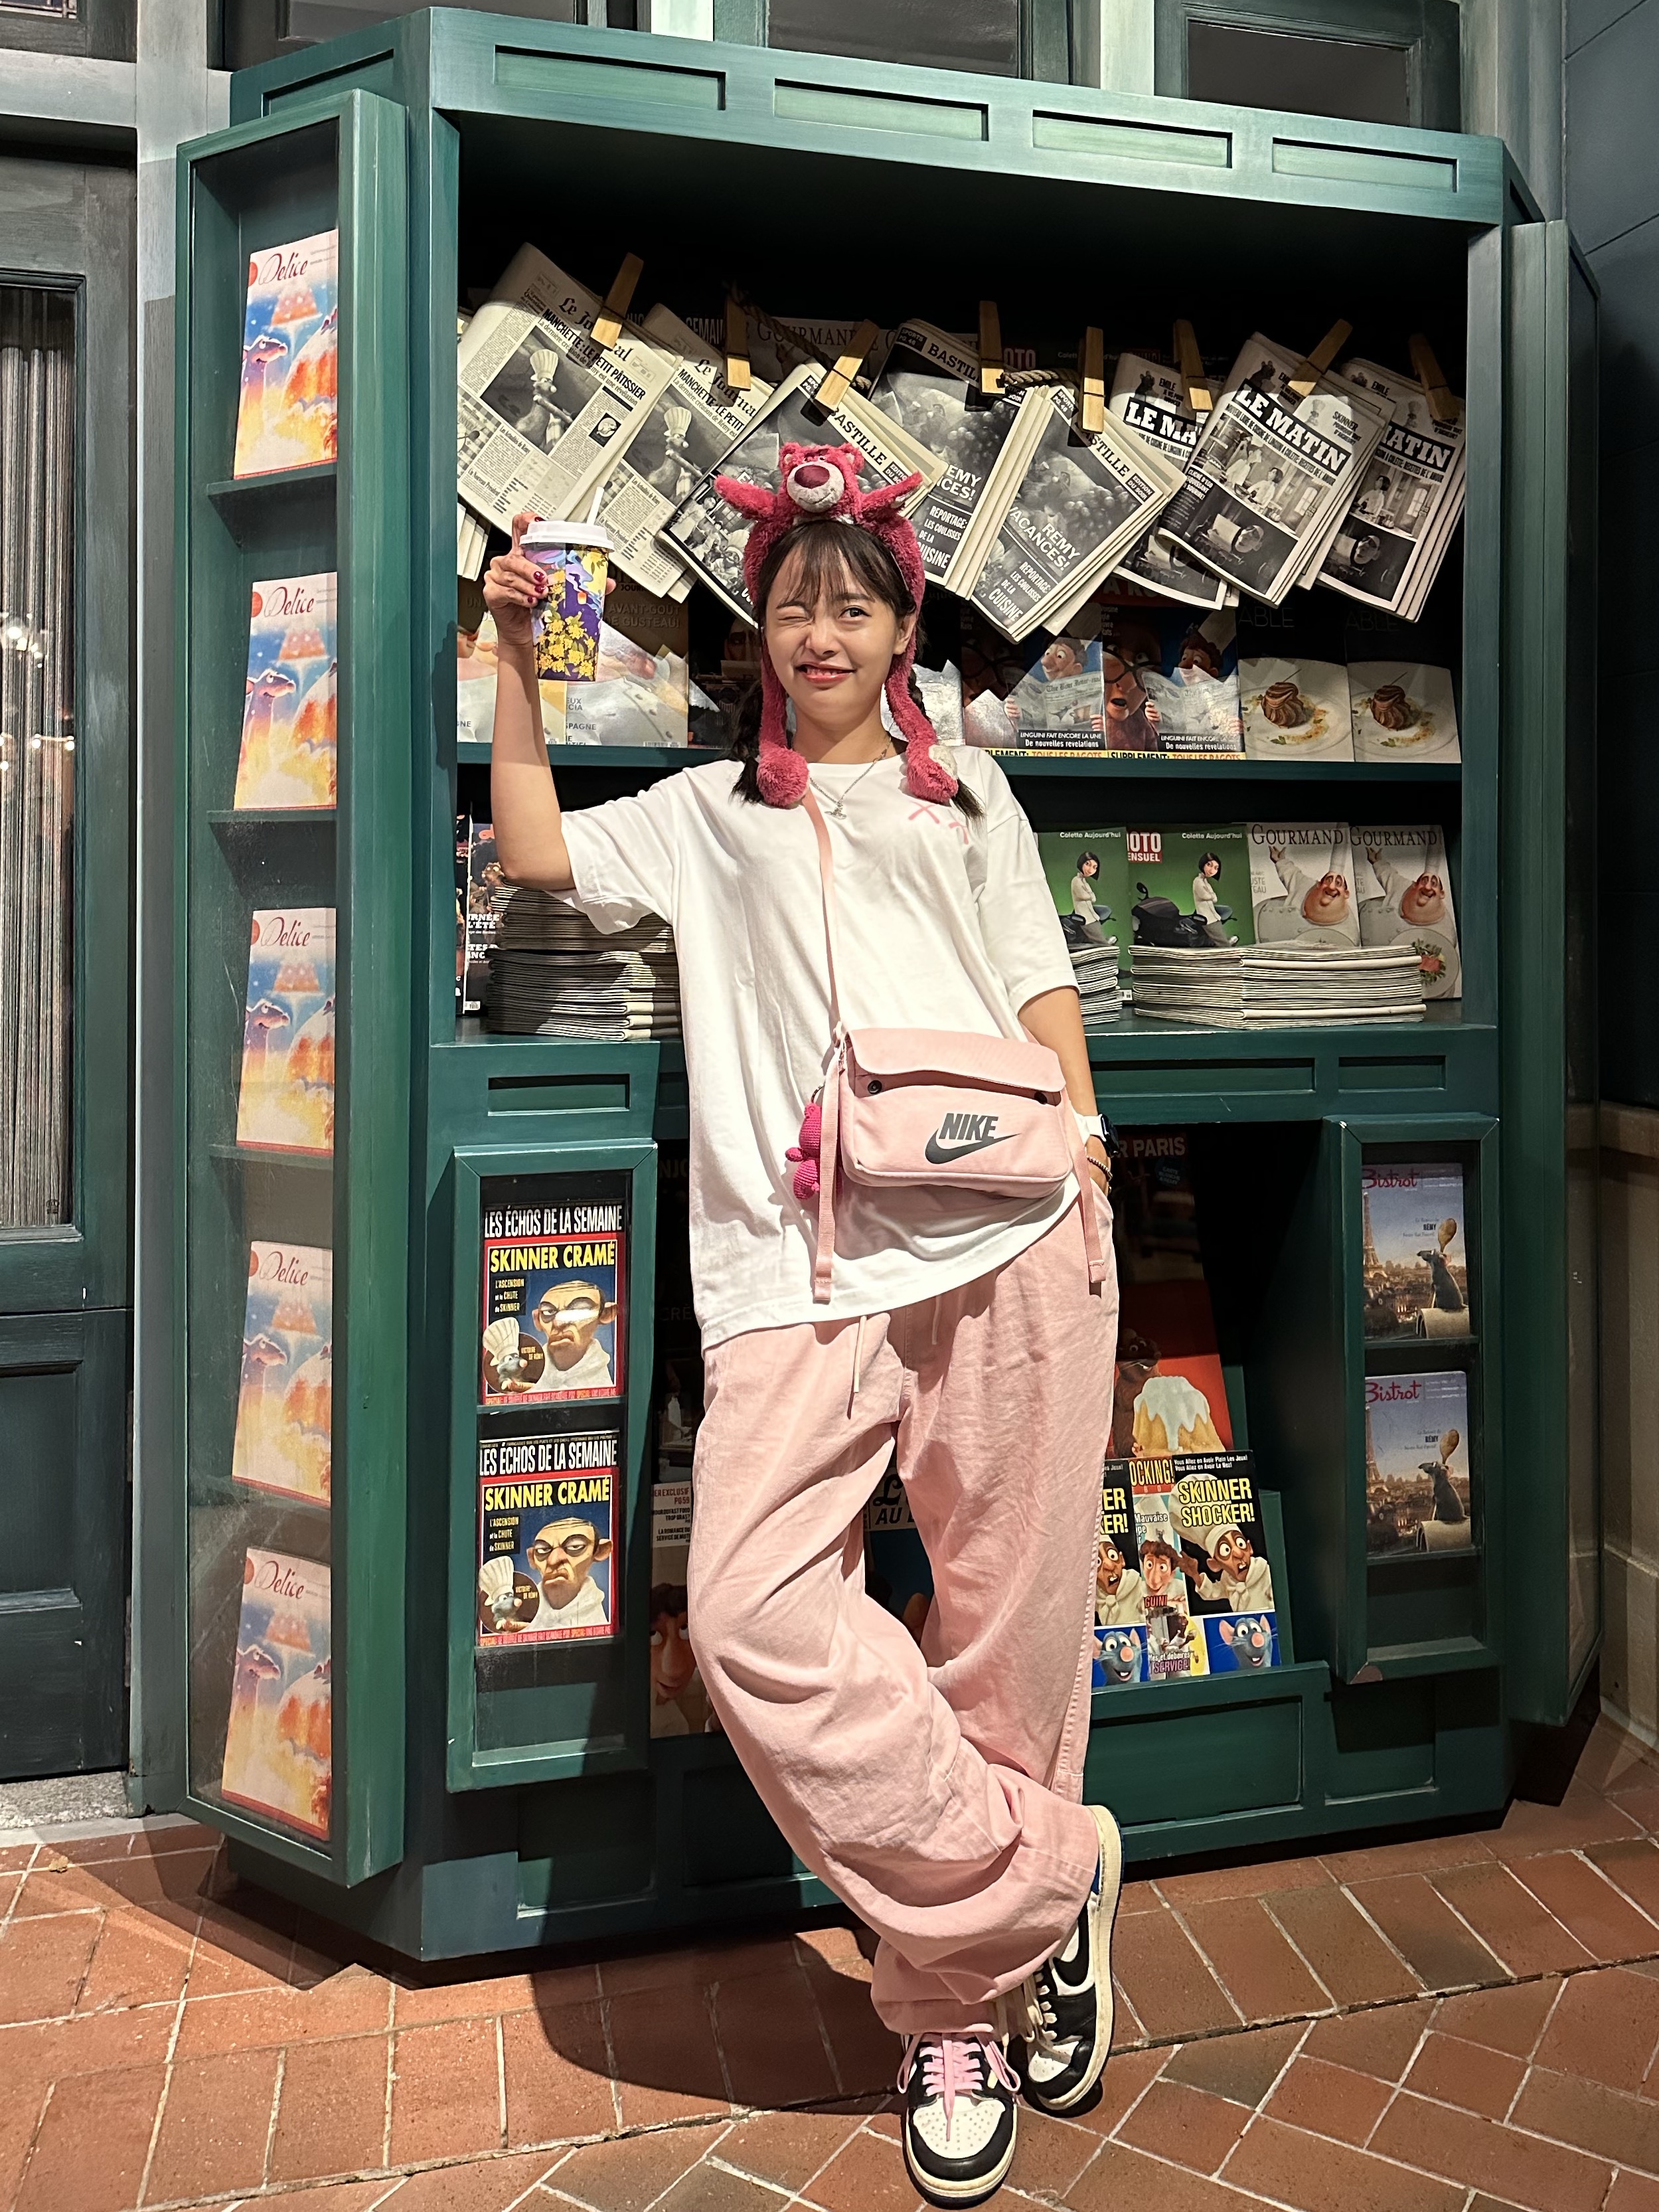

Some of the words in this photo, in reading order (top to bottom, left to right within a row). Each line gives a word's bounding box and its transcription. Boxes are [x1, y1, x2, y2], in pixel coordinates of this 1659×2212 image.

[258, 252, 308, 286] Delice
[536, 318, 547, 329] La
[544, 324, 568, 347] dernière
[557, 294, 582, 318] Le
[574, 308, 635, 364] Joal
[582, 345, 595, 358] LE
[591, 352, 614, 374] PETIT
[610, 366, 648, 400] PÂTISSIER
[926, 343, 983, 383] BASTIL
[1003, 347, 1036, 371] OTO
[692, 355, 716, 378] Le
[708, 371, 760, 422] Journa
[715, 404, 728, 417] LE
[723, 411, 744, 432] PETIT
[1122, 400, 1160, 434] LE
[1233, 383, 1271, 418] LE
[1264, 406, 1346, 473] MATIN
[1332, 410, 1359, 432] SKINNER
[1082, 428, 1130, 477] STILLE
[889, 463, 908, 481] EDITIO
[945, 463, 981, 489] EMY
[1132, 475, 1152, 495] EDITION
[1127, 479, 1135, 488] DU
[1133, 485, 1147, 501] SOIR
[923, 518, 935, 530] LES
[933, 522, 962, 542] COULISSES
[929, 504, 969, 531] REPORTAGE:
[918, 529, 928, 540] DE
[925, 533, 935, 543] LA
[1000, 578, 1010, 589] DE
[1006, 585, 1016, 595] LA
[1009, 570, 1022, 582] LES
[264, 586, 314, 618] Delice
[988, 586, 1024, 622] CUISINE
[1127, 832, 1161, 853] OTO
[1251, 823, 1344, 845] GOURMAND
[1350, 825, 1437, 847] GOURMAND
[260, 916, 310, 948] Delice
[938, 1112, 998, 1142] NIKE
[1132, 1136, 1186, 1158] PARIS
[1362, 1168, 1420, 1189] Bistrot
[485, 1211, 503, 1238] LES
[505, 1205, 542, 1238] ÉCHOS
[543, 1209, 557, 1235] DE
[559, 1207, 572, 1234] LA
[574, 1205, 622, 1233] SEMAINE
[258, 1250, 309, 1287] Delice
[490, 1245, 559, 1273] SKINNER
[1365, 1380, 1422, 1404] Bistrot
[479, 1448, 497, 1476] LES
[499, 1442, 536, 1475] ÉCHOS
[538, 1446, 552, 1472] DE
[554, 1444, 566, 1470] LA
[568, 1440, 617, 1468] SEMAINE
[1129, 1459, 1175, 1486] OCKING!
[485, 1482, 554, 1512] SKINNER
[558, 1476, 610, 1504] CRAMÉ
[1103, 1488, 1127, 1511] ER
[1177, 1478, 1253, 1505] SKINNER
[489, 1516, 519, 1527] L'ASCENSION
[875, 1507, 903, 1525] AU
[1134, 1511, 1168, 1523] Mauvaise
[1180, 1502, 1256, 1527] SHOCKER!
[254, 1560, 304, 1600] Delice
[1143, 1595, 1168, 1608] GUINI
